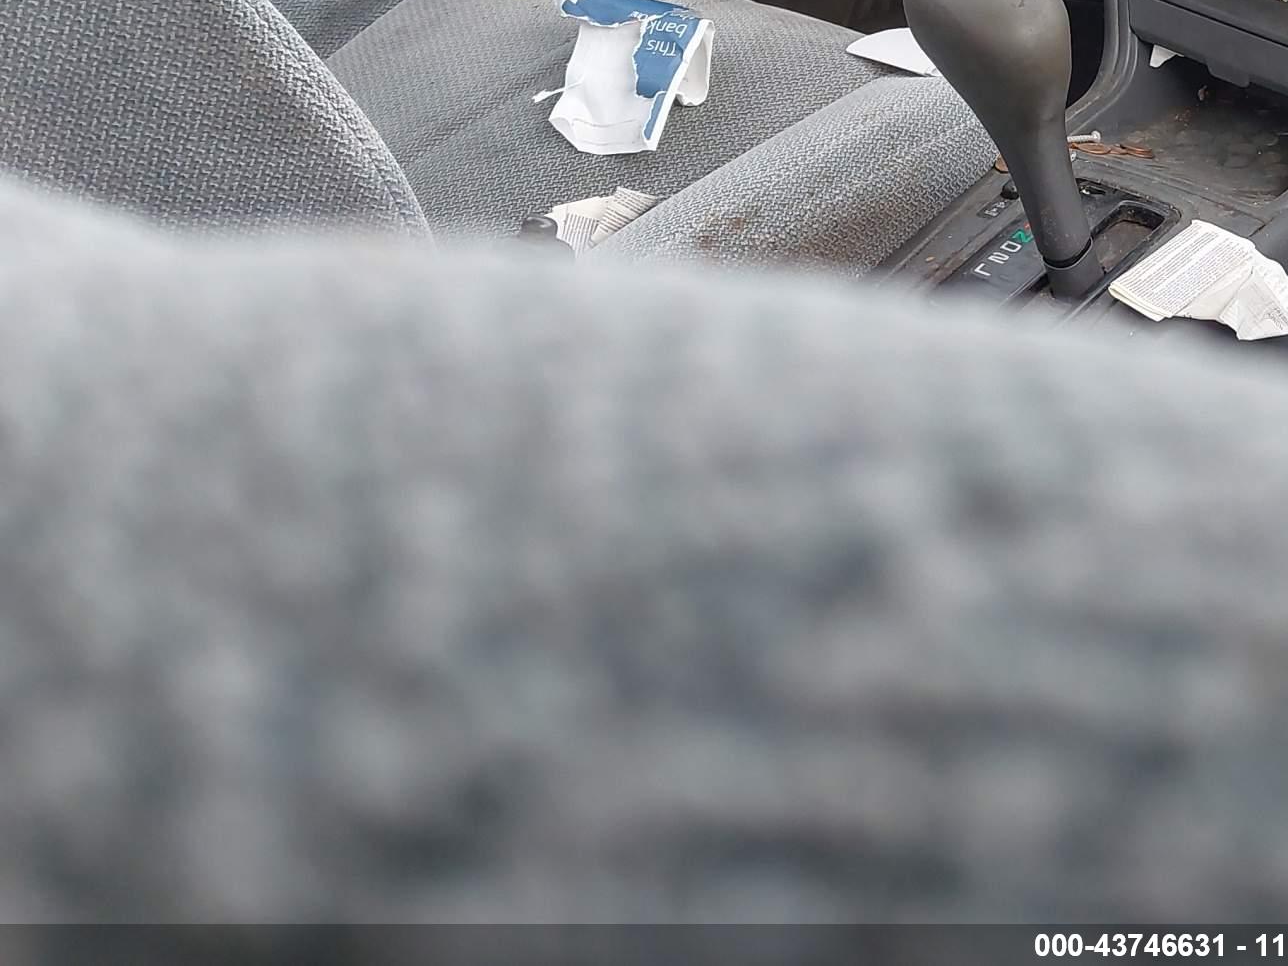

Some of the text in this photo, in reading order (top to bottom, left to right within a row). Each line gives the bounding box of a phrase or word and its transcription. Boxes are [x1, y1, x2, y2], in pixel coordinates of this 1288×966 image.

[646, 20, 689, 39] bank
[646, 39, 677, 57] This
[974, 263, 991, 277] L
